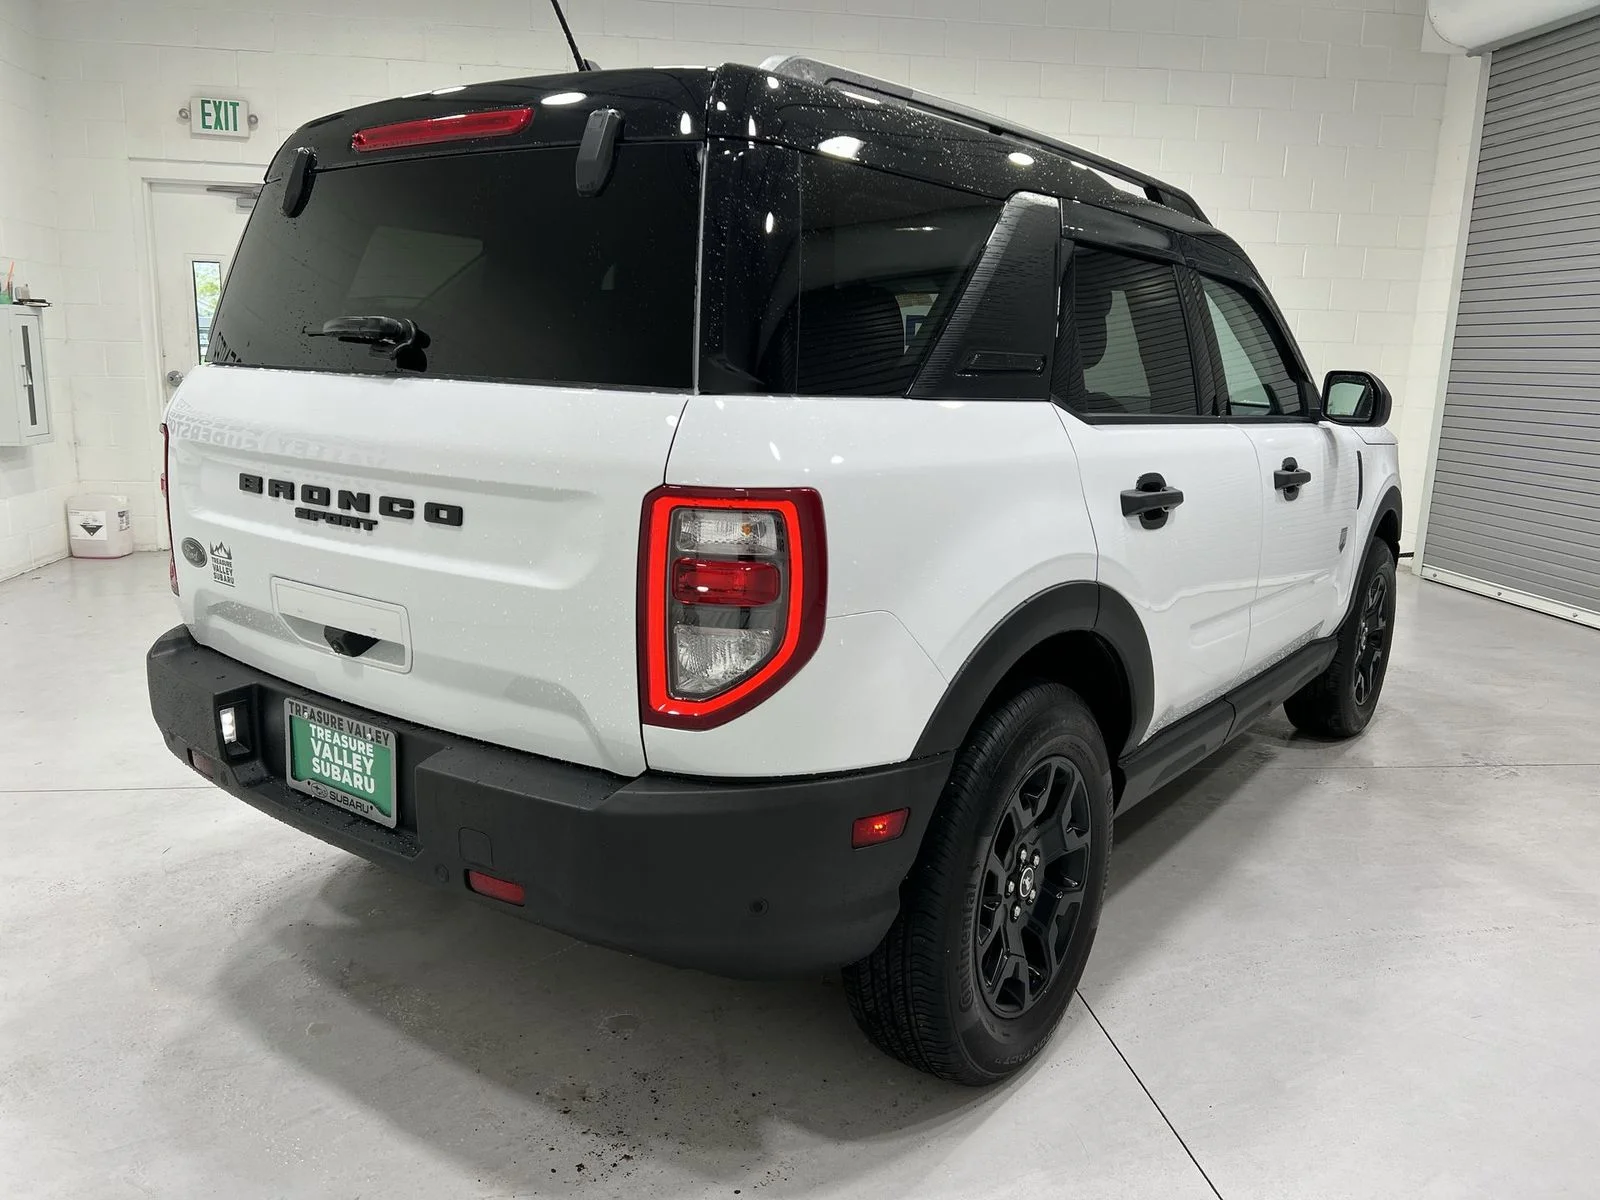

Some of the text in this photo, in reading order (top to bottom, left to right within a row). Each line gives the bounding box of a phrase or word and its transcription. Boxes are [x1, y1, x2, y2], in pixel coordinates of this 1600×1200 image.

[201, 99, 239, 131] EXIT
[239, 472, 463, 526] BRONCO
[294, 506, 378, 531] SPORT
[211, 556, 232, 568] TREASURE
[212, 563, 233, 577] VALLEY
[213, 572, 234, 584] SUBARU
[288, 701, 390, 746] TREASURE VALLEY
[309, 723, 374, 757] TREASURE
[310, 738, 374, 775] VALLEY
[311, 757, 375, 793] SUBARU
[329, 790, 370, 814] SUBARU
